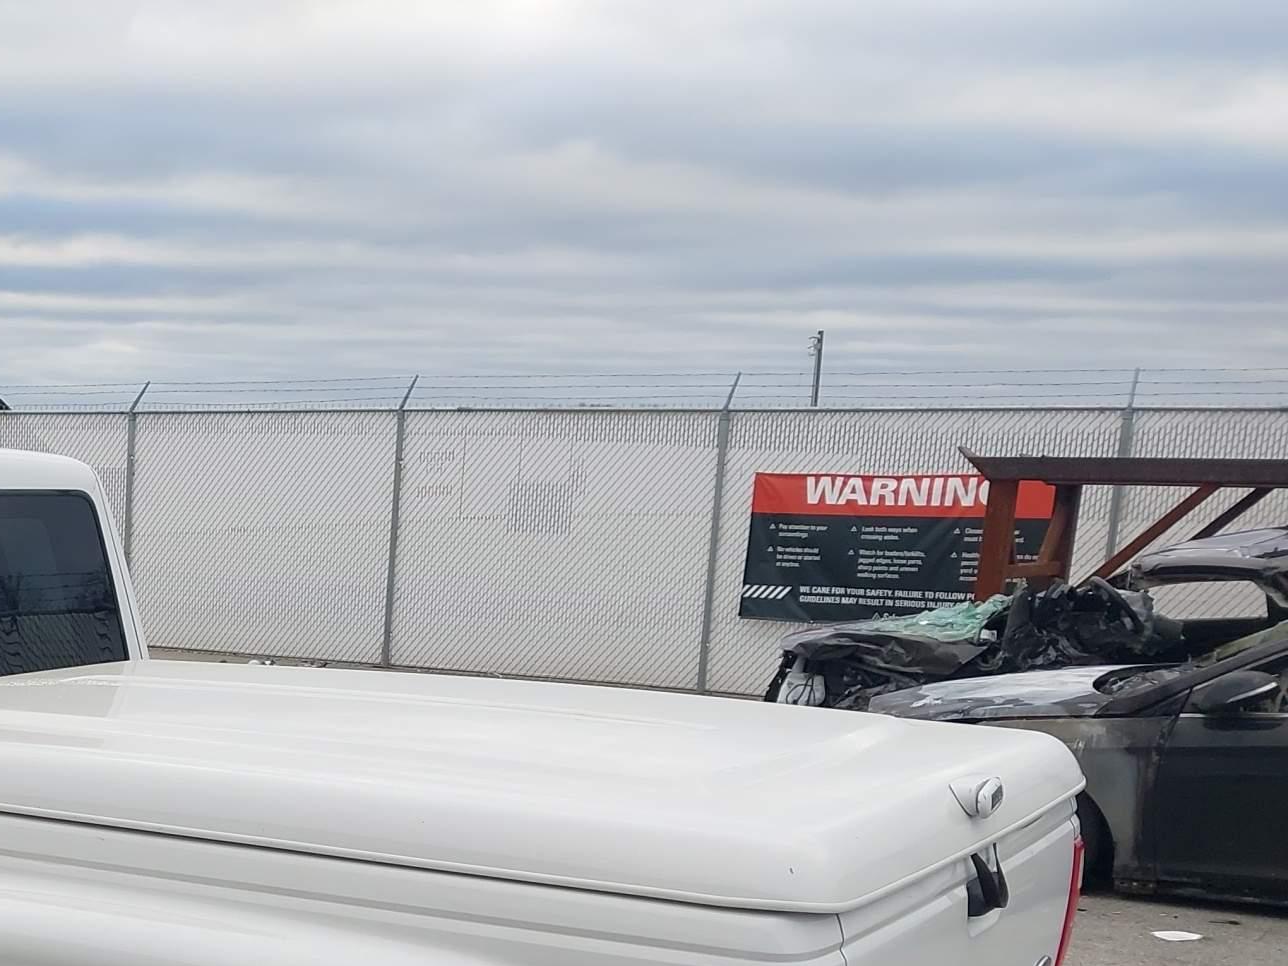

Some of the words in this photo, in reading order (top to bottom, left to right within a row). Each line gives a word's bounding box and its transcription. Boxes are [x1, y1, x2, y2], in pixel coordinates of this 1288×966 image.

[799, 586, 811, 594] WE
[812, 586, 831, 594] CARE
[831, 586, 846, 595] FOR
[846, 588, 865, 596] YOUR
[894, 590, 923, 598] FAILURE
[924, 591, 935, 599] TO
[935, 592, 965, 600] FOLLOW
[799, 595, 841, 604] GUIDELINES
[841, 597, 858, 605] MAY
[858, 598, 885, 606] RESULT
[894, 599, 926, 608] SERIOUS
